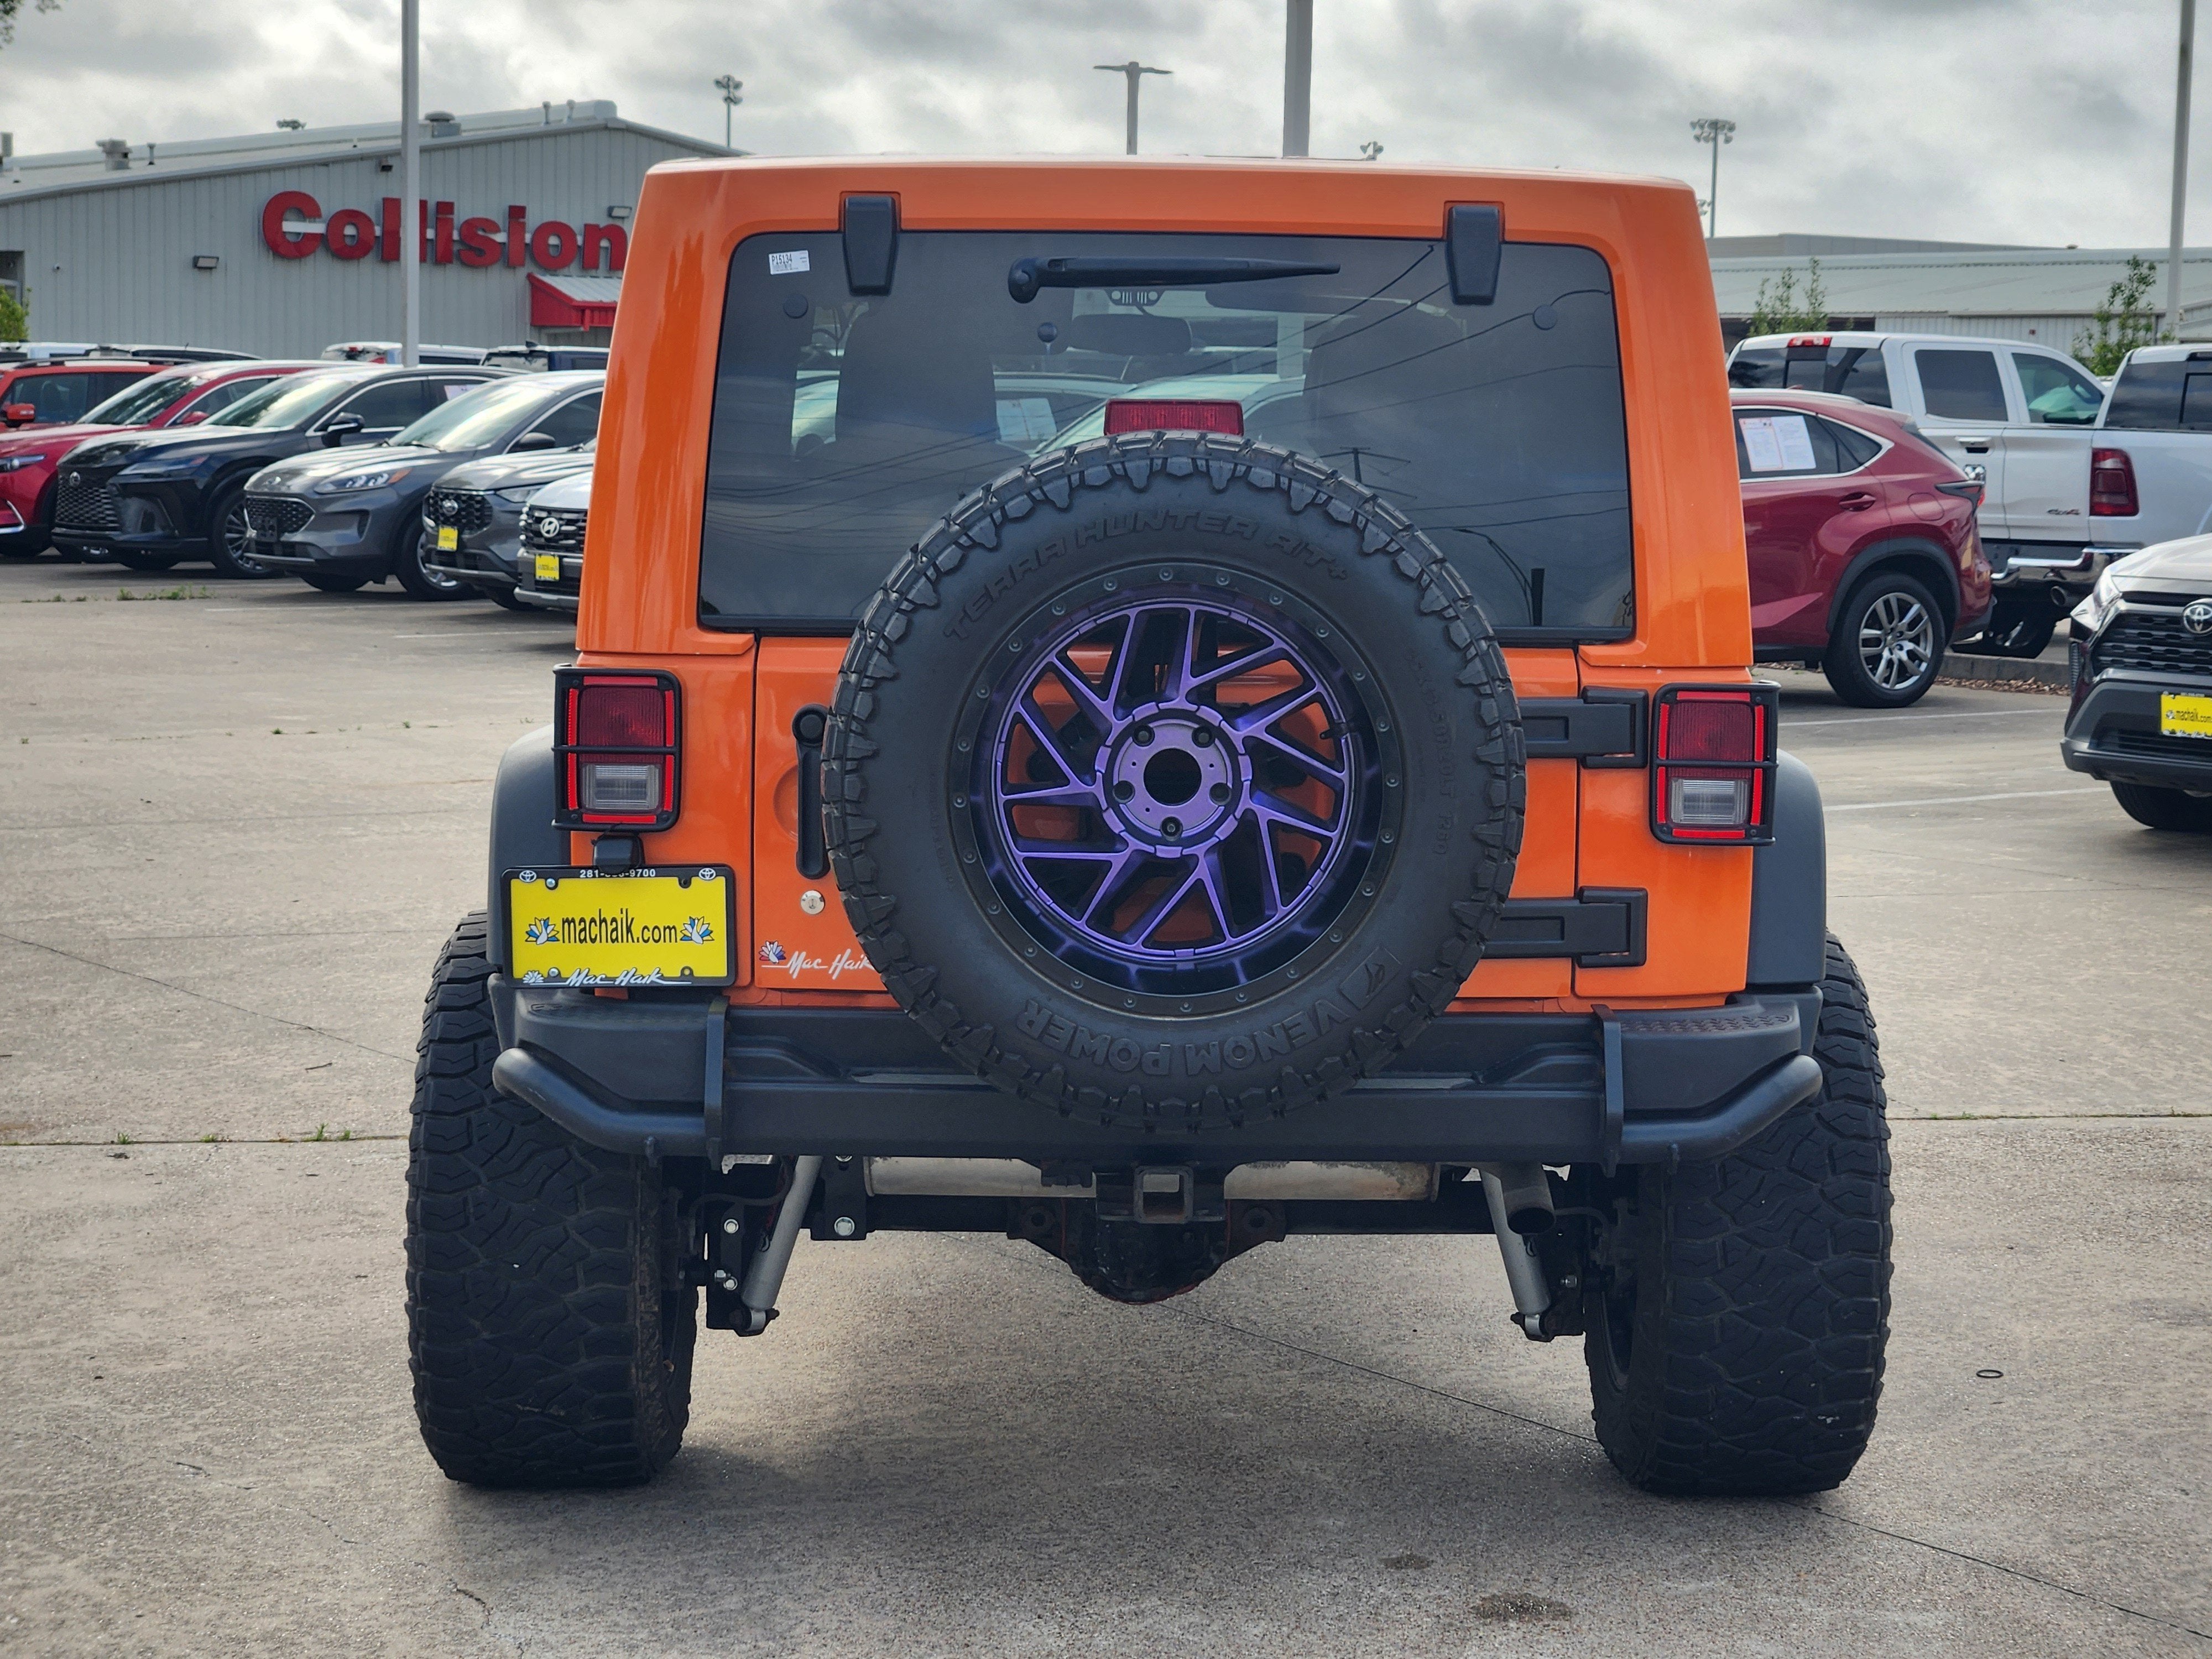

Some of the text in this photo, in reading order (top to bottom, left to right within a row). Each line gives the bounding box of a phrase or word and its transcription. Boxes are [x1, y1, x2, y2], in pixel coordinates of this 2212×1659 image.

[771, 253, 792, 265] P15134
[943, 536, 1066, 640] TERRA
[1074, 509, 1260, 549] HUNTER
[580, 869, 656, 878] 281--9700
[562, 908, 677, 944] machaik.com
[564, 967, 666, 985] Mac Haik
[787, 948, 875, 979] Mac Haik
[1017, 999, 1353, 1076] VENOM POWER
